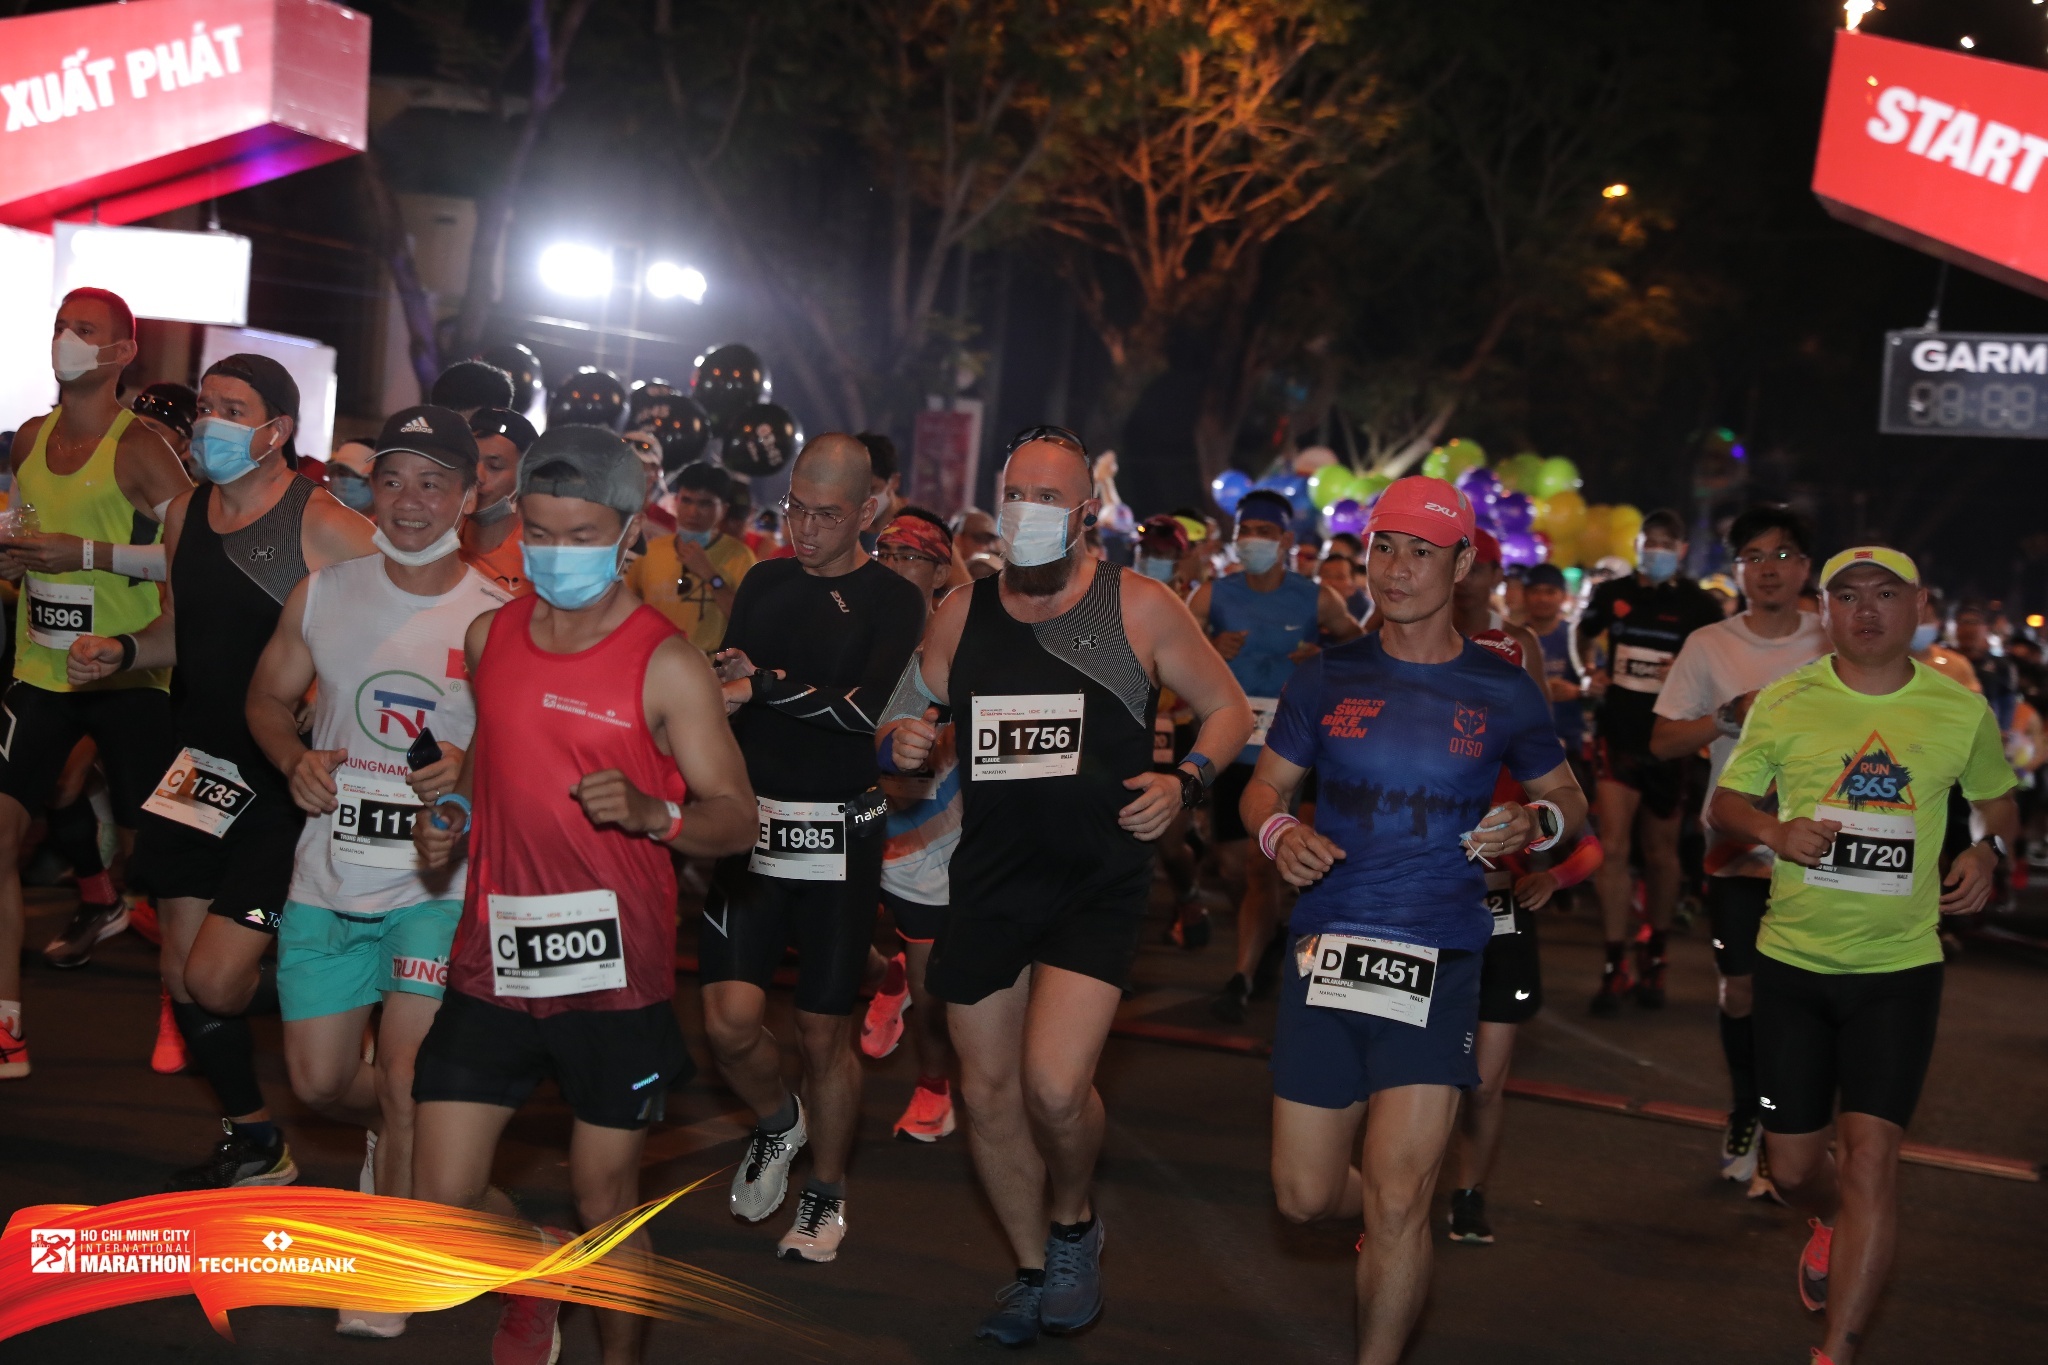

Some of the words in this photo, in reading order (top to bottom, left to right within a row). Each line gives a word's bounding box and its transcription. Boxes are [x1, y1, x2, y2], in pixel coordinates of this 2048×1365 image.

[0, 47, 116, 132] XUẤT
[125, 21, 243, 99] PHÁT
[1866, 85, 2048, 193] START
[1911, 339, 2048, 375] GARM
[400, 425, 433, 434] adidas
[1424, 502, 1457, 518] 2XU
[35, 605, 84, 628] 1596
[1333, 704, 1384, 718] SWIM
[1343, 697, 1371, 706] MADE
[1371, 699, 1386, 707] TO
[1320, 714, 1362, 727] BIKE
[978, 729, 997, 751] D
[1010, 726, 1070, 750] 1756
[1328, 726, 1368, 739] RUN
[1449, 737, 1483, 758] OTSO
[341, 757, 408, 776] RUNGNAM
[1860, 762, 1890, 775] RUN
[167, 769, 186, 788] C
[189, 776, 241, 808] 1735
[1849, 775, 1897, 798] 365
[339, 804, 357, 827] B
[371, 809, 417, 835] 111
[777, 827, 835, 849] 1985
[1846, 842, 1907, 868] 1720
[498, 934, 515, 960] C
[528, 928, 607, 962] 1800
[1321, 949, 1342, 971] D
[1357, 953, 1420, 988] 1451
